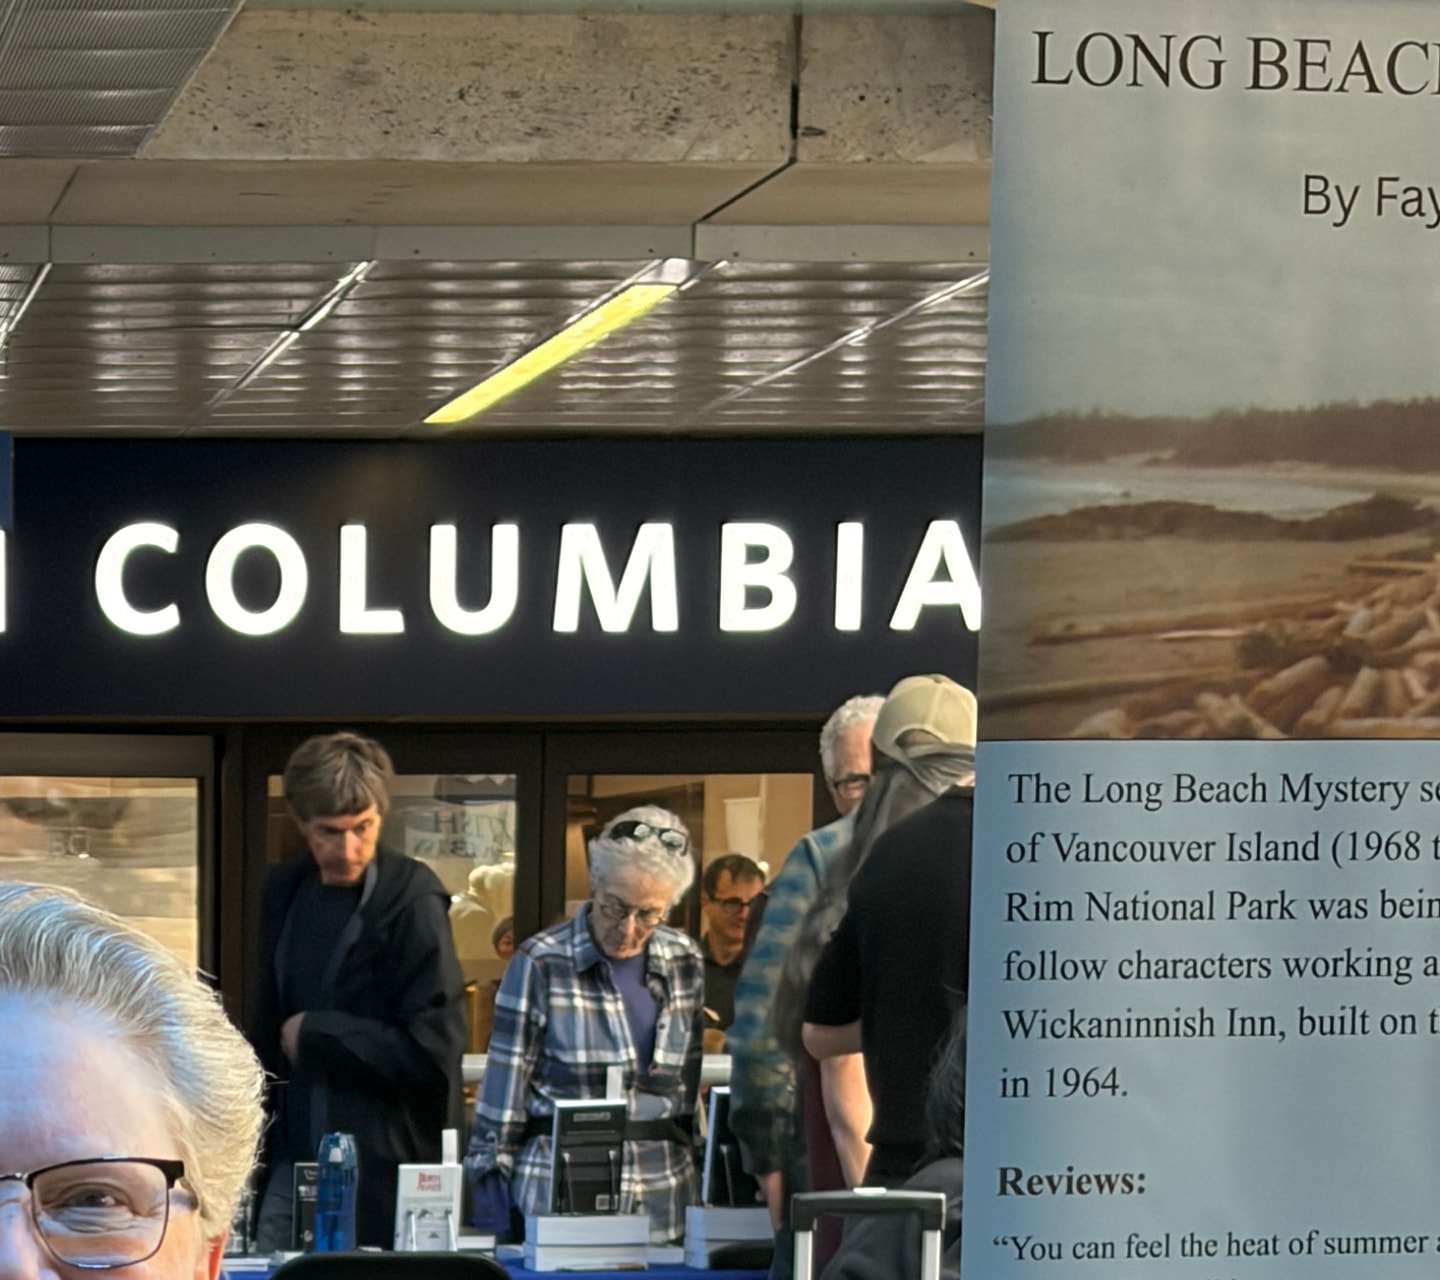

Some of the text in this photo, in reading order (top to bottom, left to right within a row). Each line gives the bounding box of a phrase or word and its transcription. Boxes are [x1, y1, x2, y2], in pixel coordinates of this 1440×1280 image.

[1032, 31, 1440, 95] LONG BEAC
[1304, 174, 1360, 227] By
[95, 520, 981, 636] COLUMBIA
[1008, 772, 1409, 811] The Long Beach Mystery
[1007, 831, 1420, 869] of Vancouver Island (1968
[1006, 890, 1368, 922] Rim National Park was
[1005, 947, 1413, 985] follow characters working
[1002, 1005, 1417, 1042] Wickaninnish Inn, built on
[1001, 1067, 1127, 1098] in 1964.
[998, 1166, 1145, 1196] Reviews:
